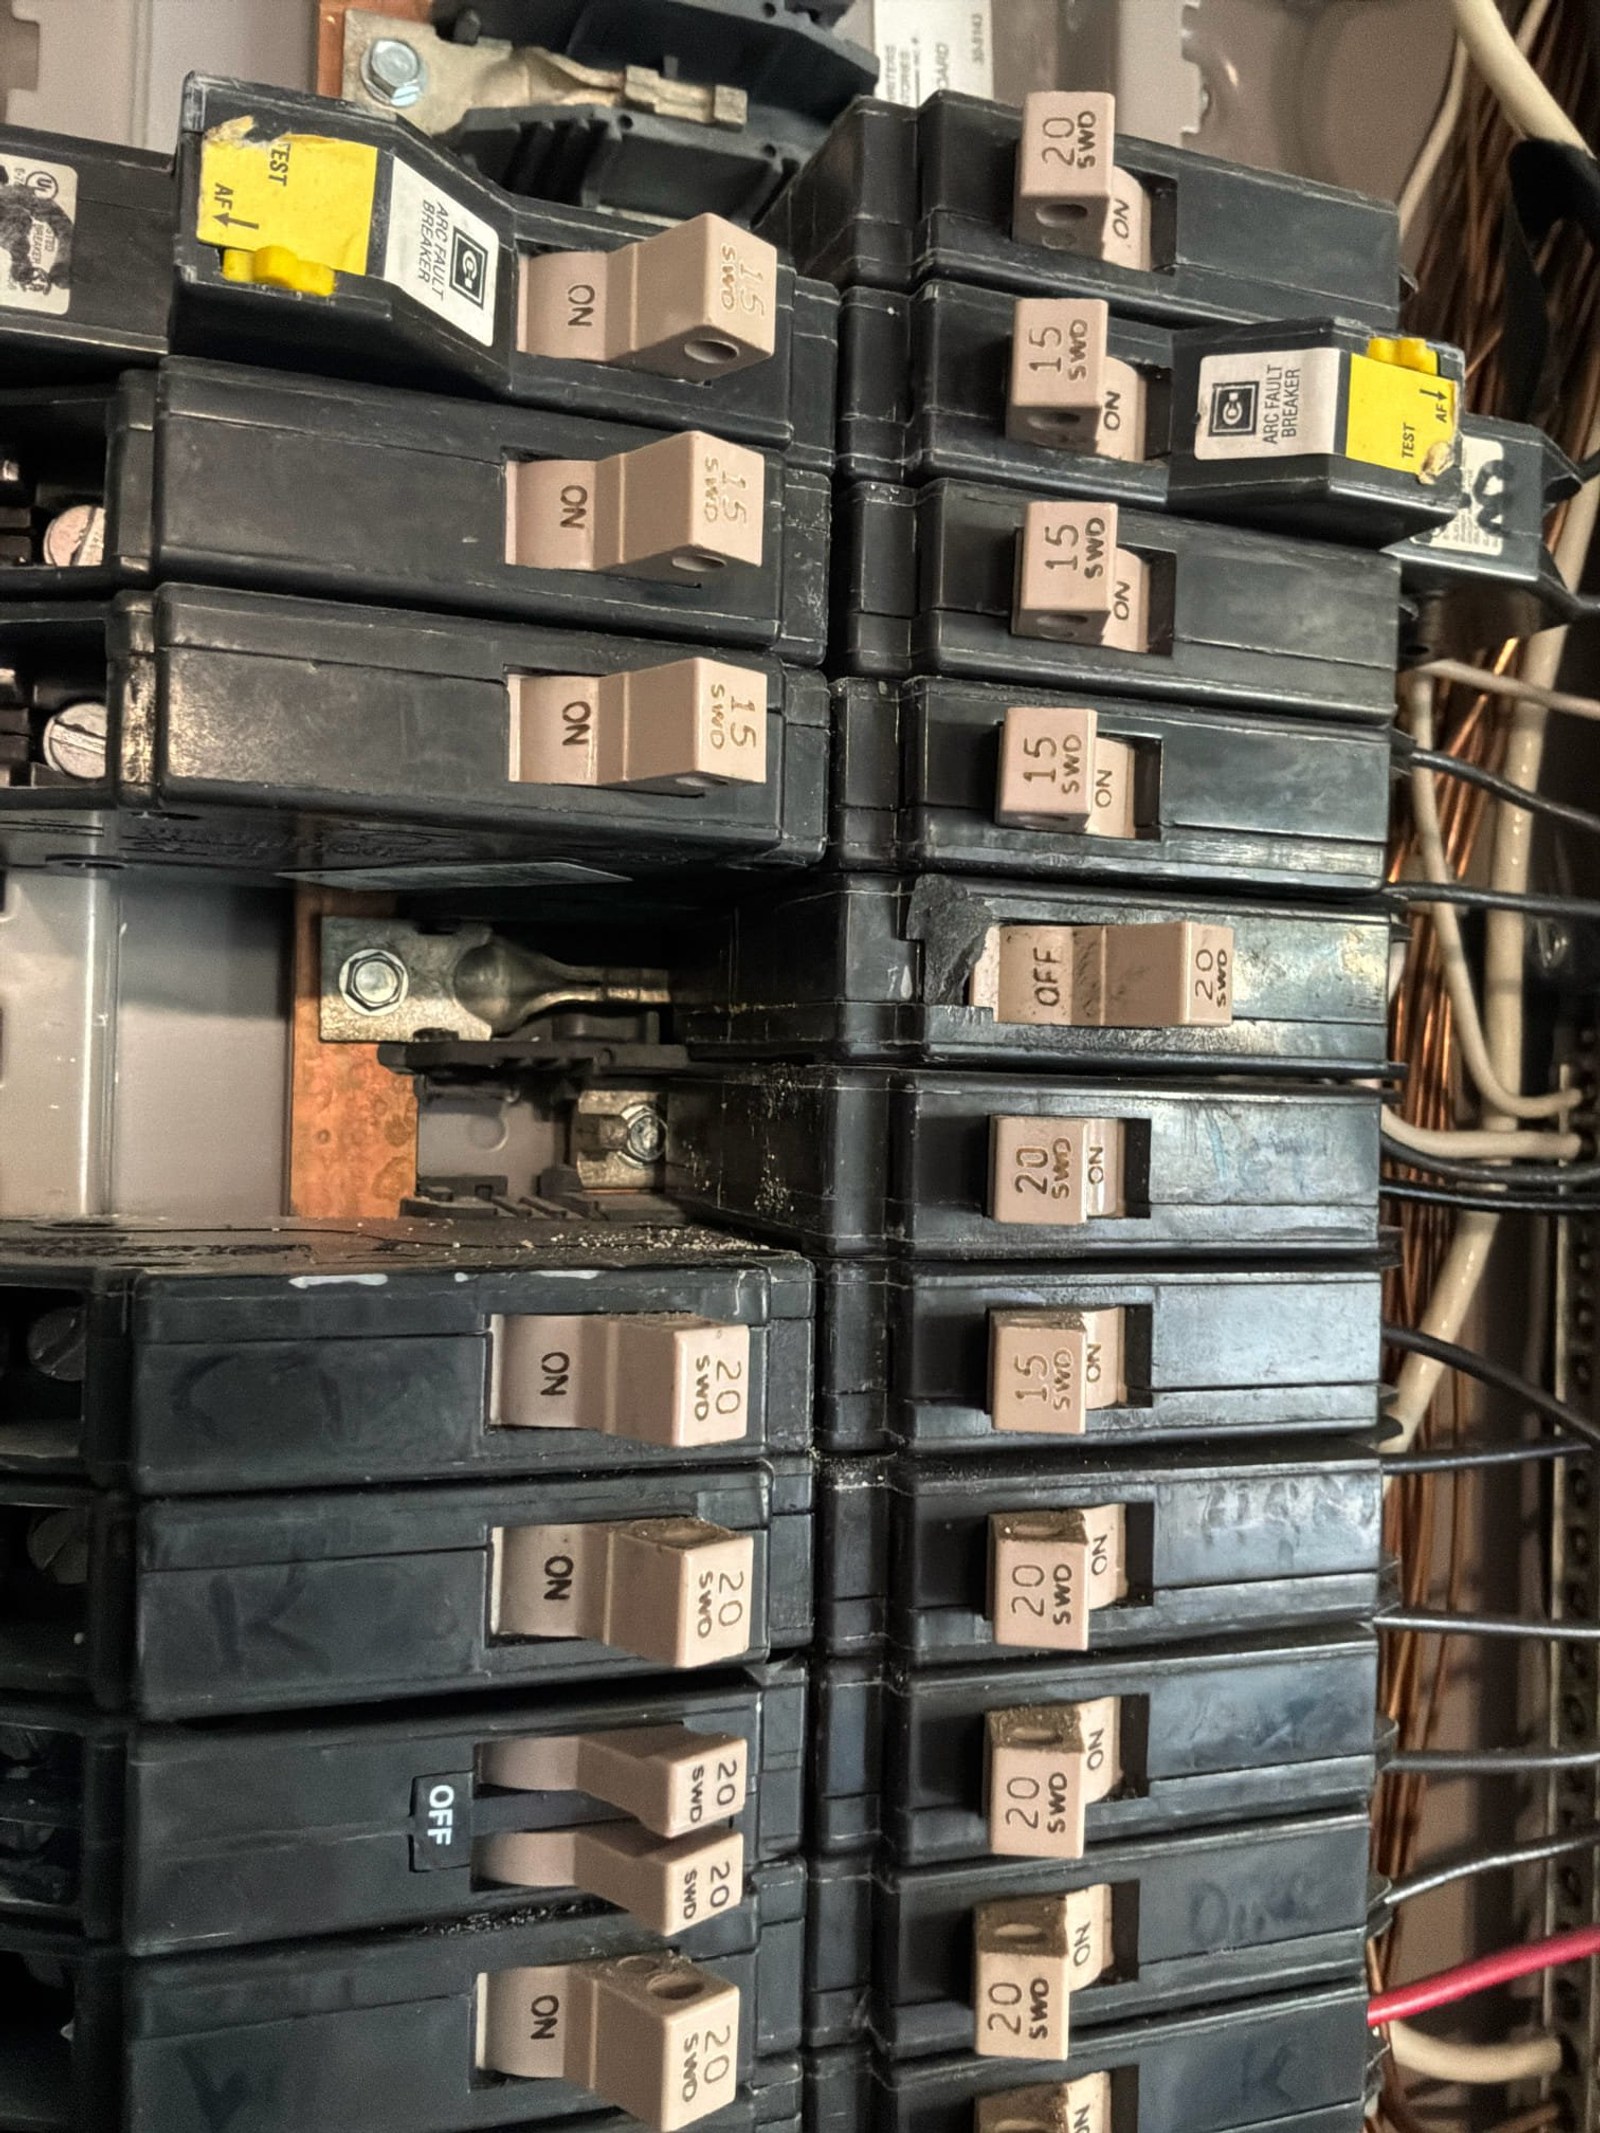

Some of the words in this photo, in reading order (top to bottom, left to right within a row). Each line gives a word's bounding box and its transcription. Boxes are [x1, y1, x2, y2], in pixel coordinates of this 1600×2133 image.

[1042, 117, 1075, 166] 20
[1077, 111, 1096, 169] SWD
[214, 182, 234, 210] AF
[435, 201, 449, 243] ARC
[1113, 198, 1130, 239] ON
[418, 199, 436, 284] BREAKER
[432, 243, 447, 302] FAULT
[721, 245, 736, 311] SWD
[740, 263, 765, 317] 15
[568, 284, 595, 327] ON
[1029, 326, 1062, 372] 15
[1069, 319, 1088, 381] SWD
[1103, 391, 1121, 431] ON
[1264, 364, 1283, 410] FAULT
[1281, 368, 1301, 438] BREAKER
[1435, 403, 1447, 423] AF
[1262, 413, 1280, 444] ARC
[1401, 422, 1416, 459] TEST
[560, 485, 588, 529] ON
[704, 457, 718, 523] SWD
[722, 471, 747, 524] 15
[1045, 524, 1079, 571] 15
[1084, 517, 1105, 579] SWD
[1113, 581, 1130, 621] ON
[562, 701, 591, 746] ON
[710, 684, 725, 749] SWD
[731, 696, 757, 748] 15
[1023, 736, 1057, 782] 15
[1061, 734, 1082, 794] SWD
[1095, 769, 1113, 808] ON
[1033, 947, 1061, 1007] OFF
[1195, 949, 1213, 1000] 20
[1216, 949, 1227, 1008] SWD
[1015, 1147, 1048, 1195] 20
[1051, 1138, 1071, 1199] SWD
[1088, 1146, 1104, 1185] ON
[541, 1352, 570, 1396] ON
[694, 1355, 711, 1421] SWD
[716, 1361, 742, 1415] 20
[1014, 1355, 1048, 1402] 15
[1053, 1350, 1072, 1411] SWD
[1086, 1343, 1101, 1383] ON
[543, 1555, 574, 1601] ON
[1091, 1534, 1108, 1576] ON
[697, 1571, 713, 1639] SWD
[718, 1571, 744, 1627] 20
[1011, 1564, 1045, 1617] 20
[1053, 1564, 1072, 1625] SWD
[1087, 1728, 1104, 1771] ON
[690, 1764, 704, 1823] SWD
[716, 1760, 738, 1806] 20
[1006, 1776, 1040, 1829] 20
[1047, 1772, 1068, 1833] SWD
[427, 1784, 455, 1846] OFF
[683, 1868, 698, 1920] SWD
[710, 1861, 731, 1908] 20
[1073, 1921, 1091, 1967] ON
[530, 1995, 559, 2040] ON
[987, 1982, 1022, 2036] 20
[1029, 1978, 1049, 2040] SWD
[682, 2033, 699, 2103] SWD
[704, 2025, 731, 2084] 20
